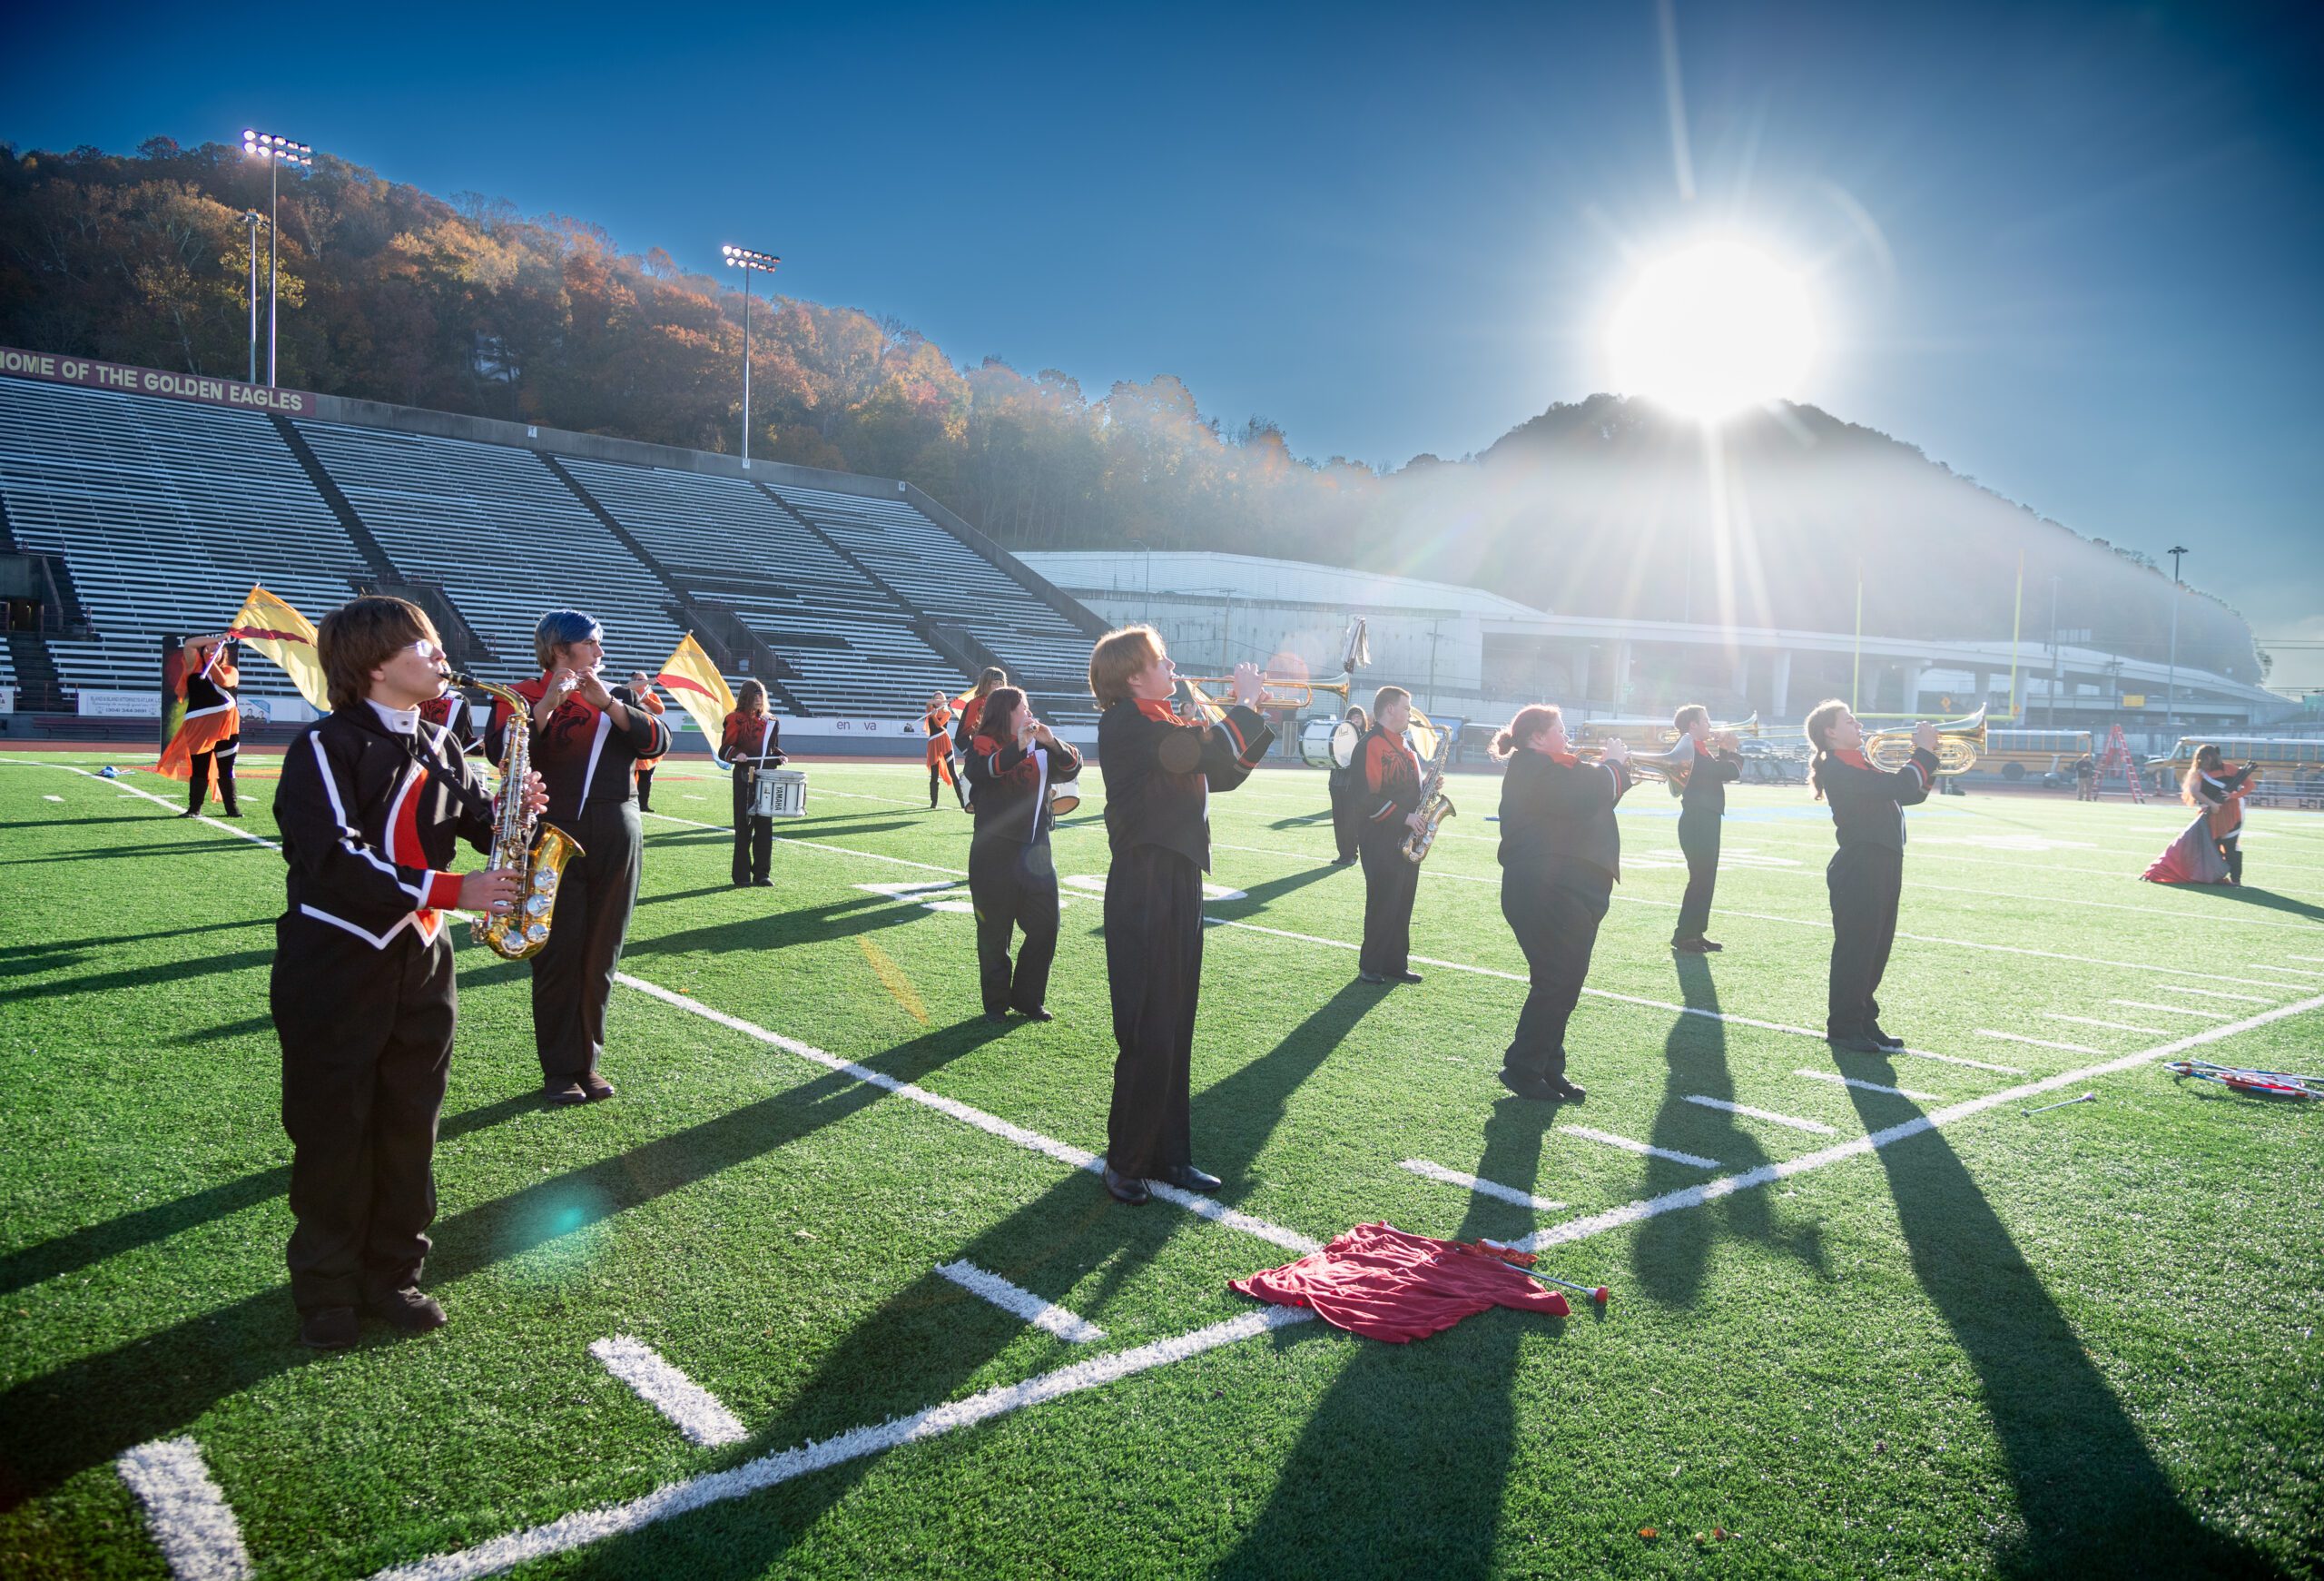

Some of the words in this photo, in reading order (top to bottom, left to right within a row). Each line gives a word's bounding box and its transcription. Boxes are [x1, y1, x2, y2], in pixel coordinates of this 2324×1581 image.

[62, 361, 89, 380] OF
[95, 365, 137, 388] THE
[143, 372, 222, 400] GOLDEN
[230, 385, 302, 411] EAGLES
[775, 786, 783, 810] YAMAHA
